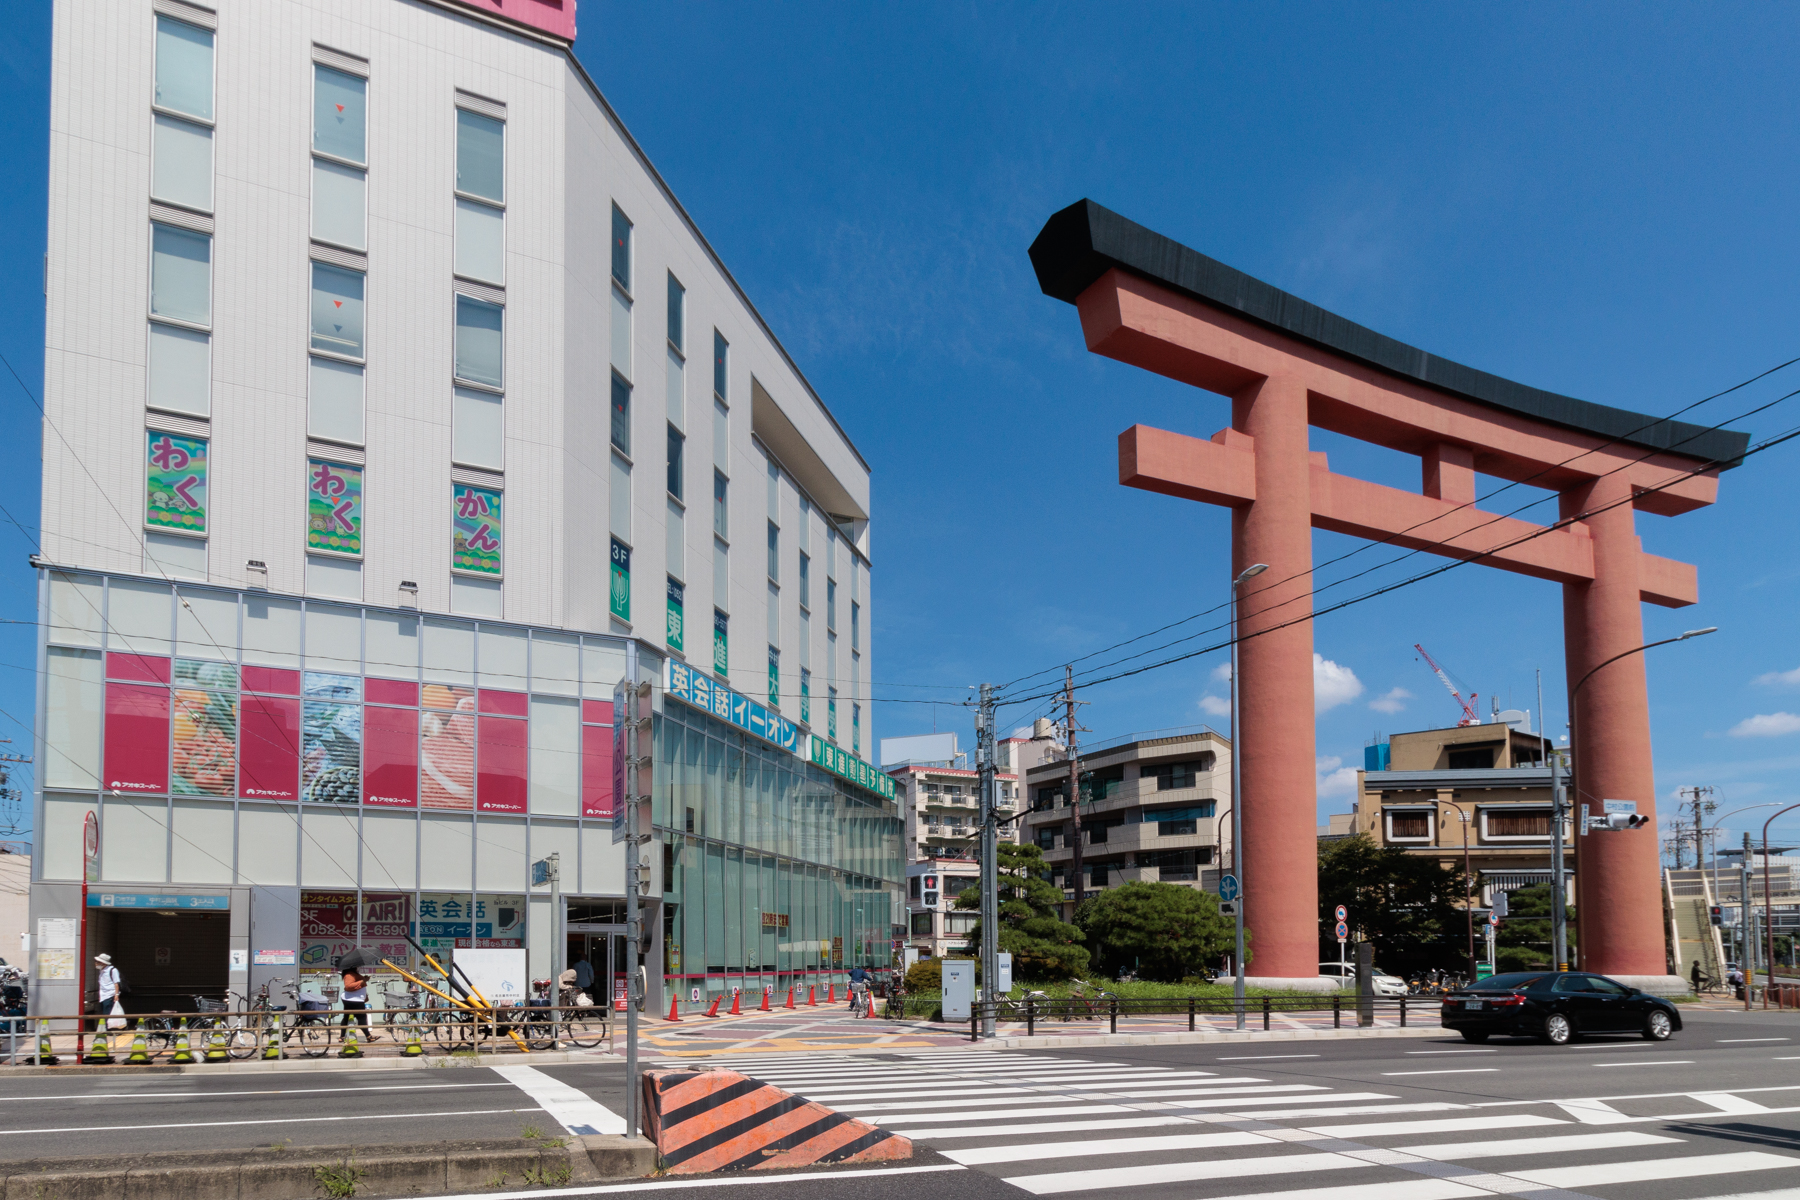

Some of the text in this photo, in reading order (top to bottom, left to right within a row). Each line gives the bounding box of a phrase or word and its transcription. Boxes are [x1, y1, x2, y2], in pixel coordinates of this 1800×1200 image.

[152, 436, 200, 510] わく
[312, 463, 355, 533] わく
[456, 488, 500, 552] かん
[612, 544, 627, 564] 3F
[667, 608, 682, 644] 東
[714, 637, 727, 670] 進
[121, 781, 161, 789] アオキスーパー
[378, 796, 411, 804] アオキスーパー
[301, 910, 318, 921] 3F
[420, 900, 486, 919] 英会話
[421, 939, 439, 948] 東進
